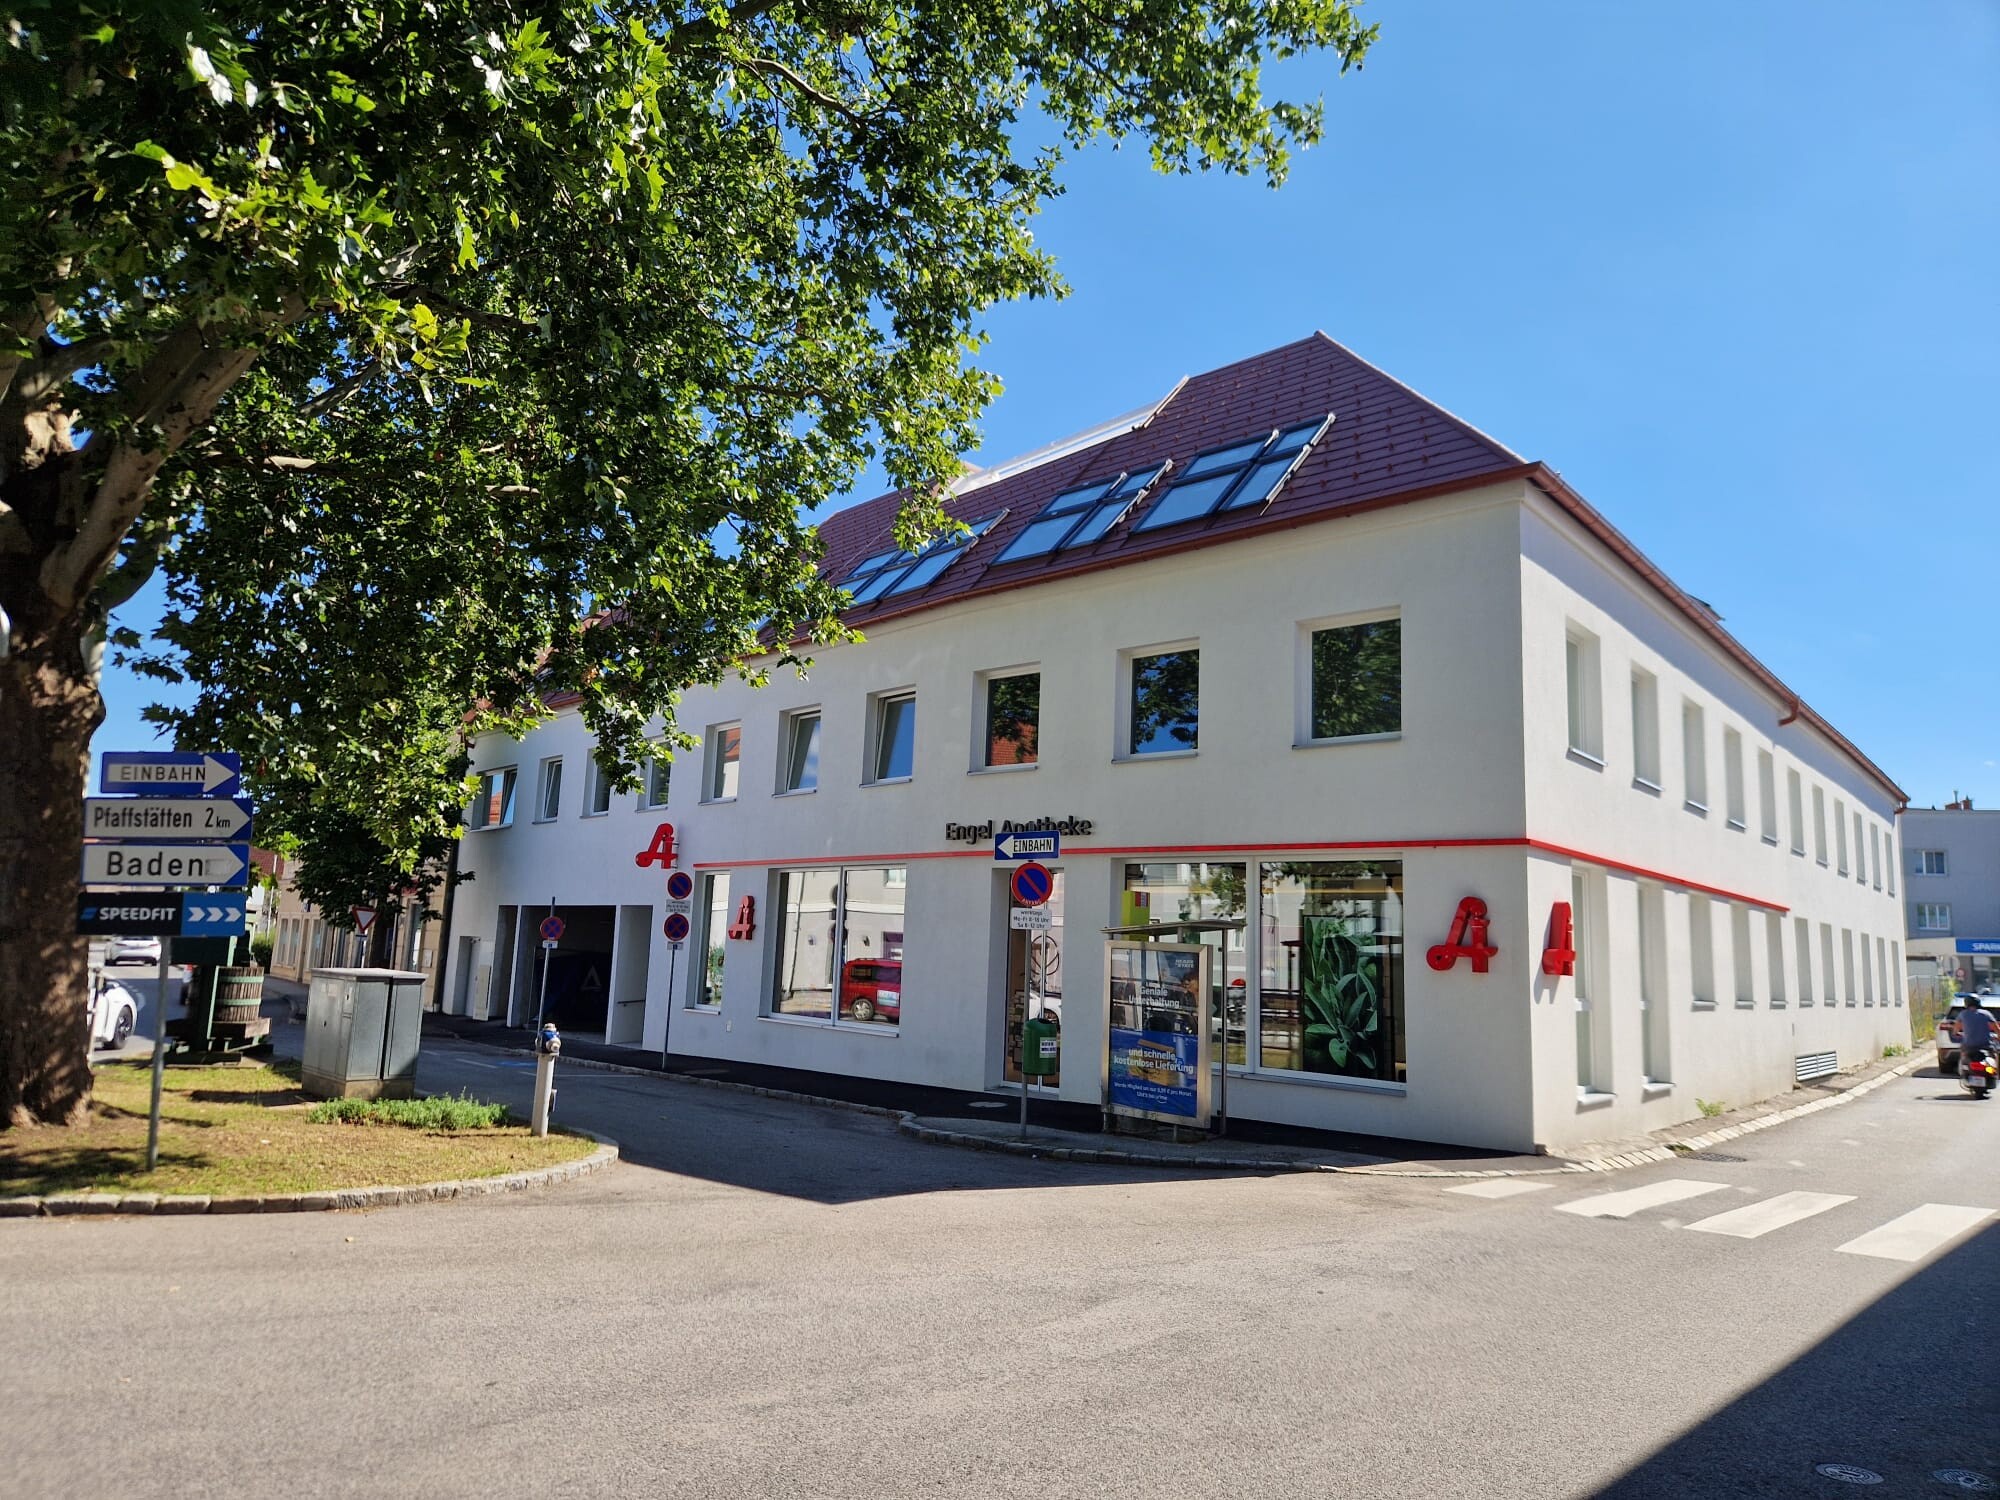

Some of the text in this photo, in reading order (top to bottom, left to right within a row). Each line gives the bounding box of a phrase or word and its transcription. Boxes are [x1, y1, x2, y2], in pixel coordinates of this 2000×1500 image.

[120, 766, 206, 781] EINBAHN
[94, 806, 231, 828] Pfaffstätten 2 km
[945, 820, 993, 845] Engel
[1013, 839, 1052, 852] EINBAHN
[107, 851, 203, 876] Baden
[99, 907, 176, 920] SPEEDFIT
[1140, 985, 1168, 996] Geniale
[1128, 1049, 1143, 1057] und
[1113, 1055, 1194, 1074] kostenlose Lieferung
